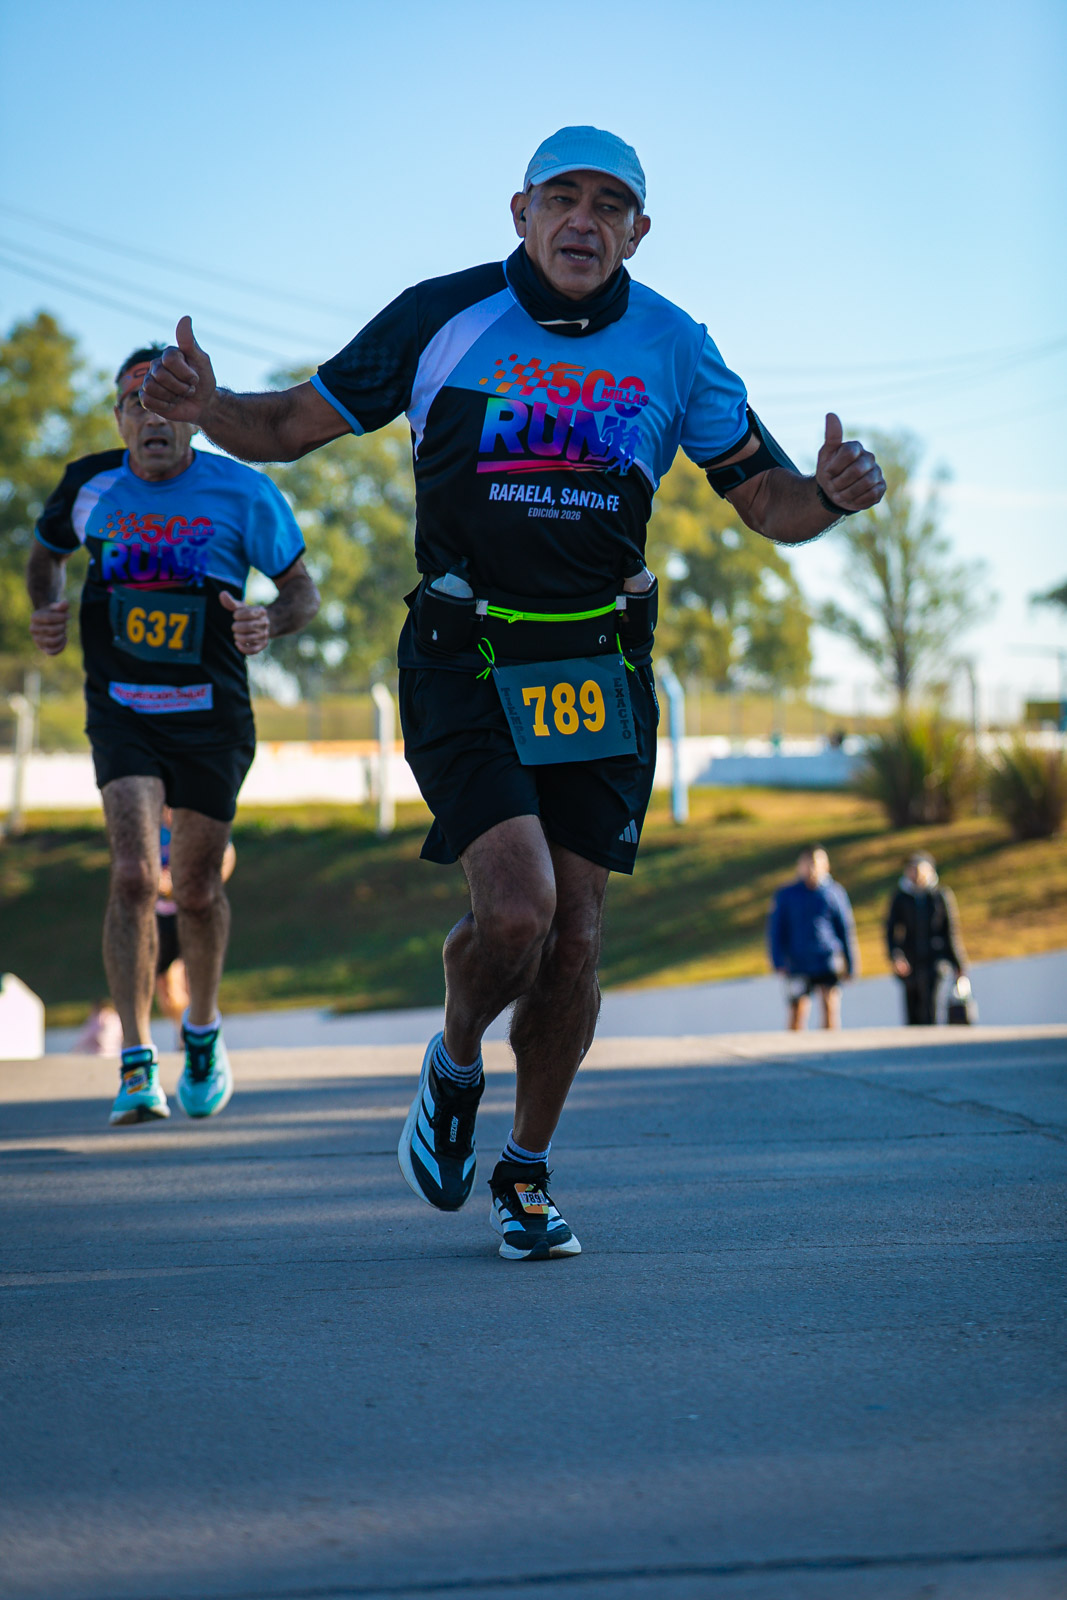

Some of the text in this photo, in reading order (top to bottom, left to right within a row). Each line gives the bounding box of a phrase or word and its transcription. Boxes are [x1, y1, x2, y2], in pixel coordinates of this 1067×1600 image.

[601, 387, 650, 407] MILLAS
[478, 397, 620, 462] RUN
[489, 483, 620, 513] RAFAELA, SANTA FE
[528, 506, 581, 521] EDICIÓN 2026
[101, 541, 199, 582] RUN
[126, 607, 189, 650] 637
[500, 687, 527, 746] TIEMPO
[521, 679, 606, 737] 789
[613, 677, 632, 740] EXACTO
[523, 1193, 541, 1203] 789
